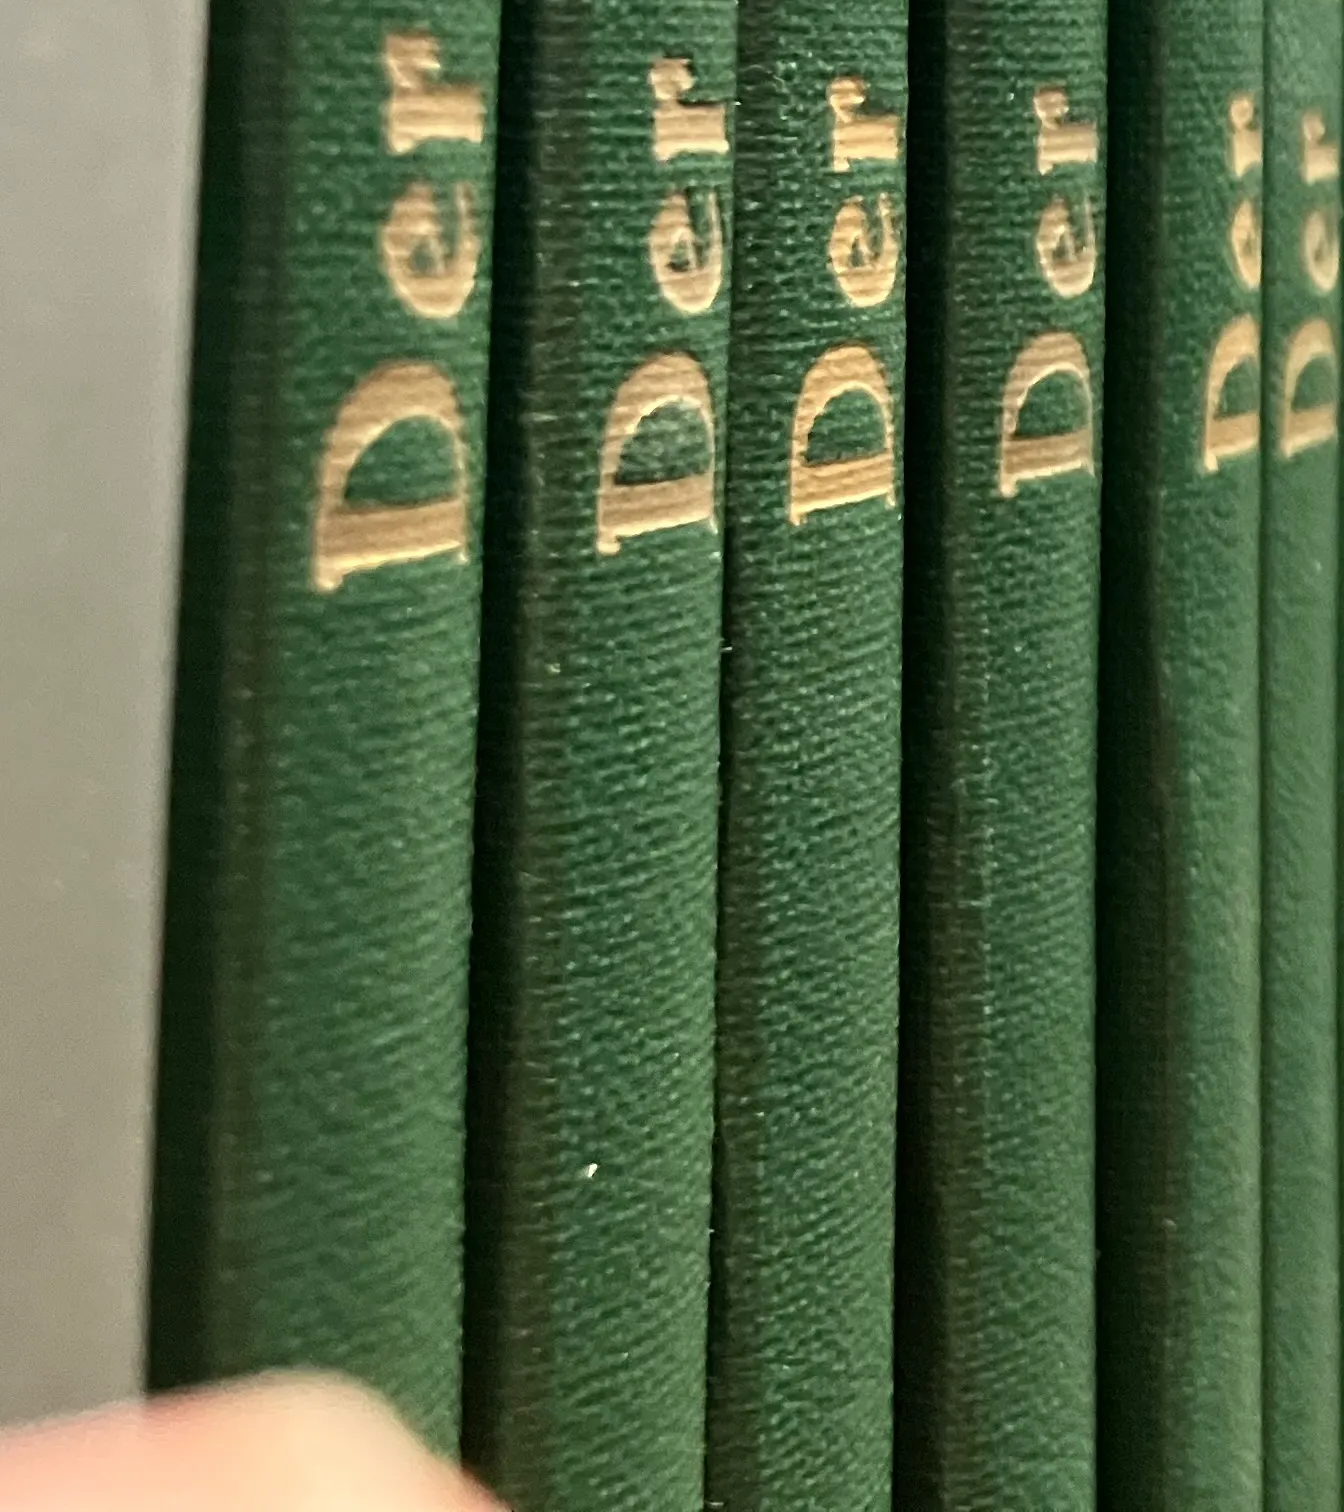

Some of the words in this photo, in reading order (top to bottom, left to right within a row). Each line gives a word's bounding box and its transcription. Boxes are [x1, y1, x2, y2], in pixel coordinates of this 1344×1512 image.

[311, 31, 483, 591] Der
[595, 56, 726, 555] Der
[788, 77, 899, 524] Der
[998, 91, 1097, 497] Der
[1203, 95, 1261, 470] Der
[1280, 113, 1339, 455] Der
